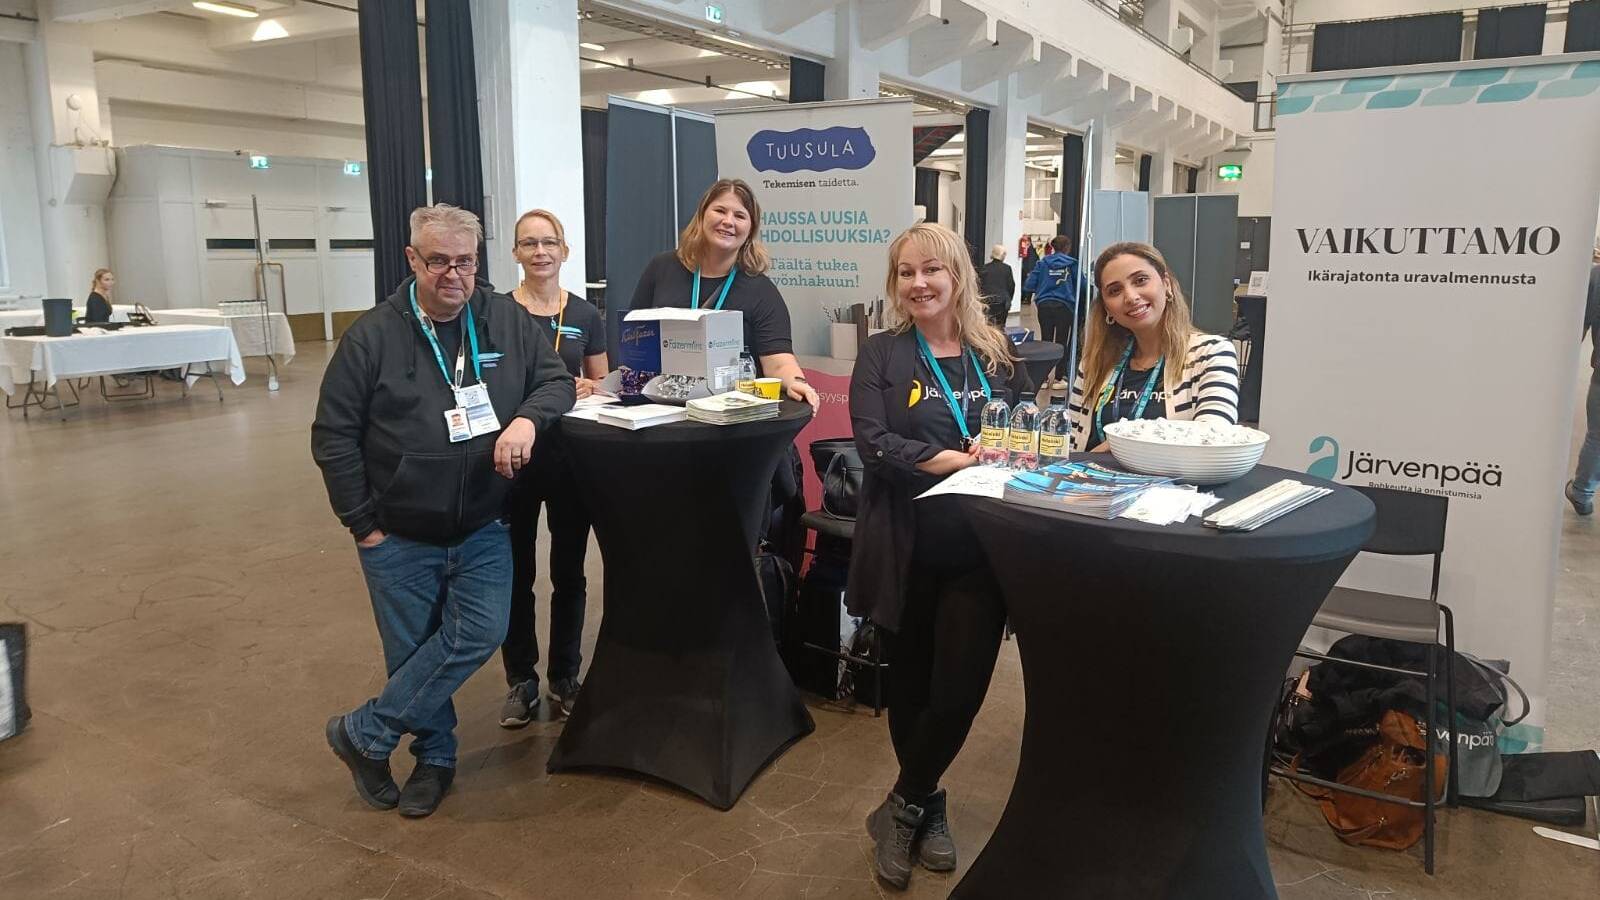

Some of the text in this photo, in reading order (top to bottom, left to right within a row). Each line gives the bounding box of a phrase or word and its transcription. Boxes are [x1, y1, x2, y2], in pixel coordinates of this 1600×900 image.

[766, 139, 855, 160] TUUSULA
[763, 177, 860, 189] Tekemisen taidetta.
[821, 210, 868, 225] UUSIA
[760, 229, 891, 244] HDOLLISUUKSIA?
[1296, 225, 1561, 256] VAIKUTTAMO
[769, 257, 858, 272] Täältä tukea
[770, 273, 860, 288] yönhakuun!
[1308, 270, 1537, 286] Ikärajatonta uravalmennusta
[1341, 450, 1503, 487] Järvenpää
[1424, 487, 1482, 500] onnistumisia
